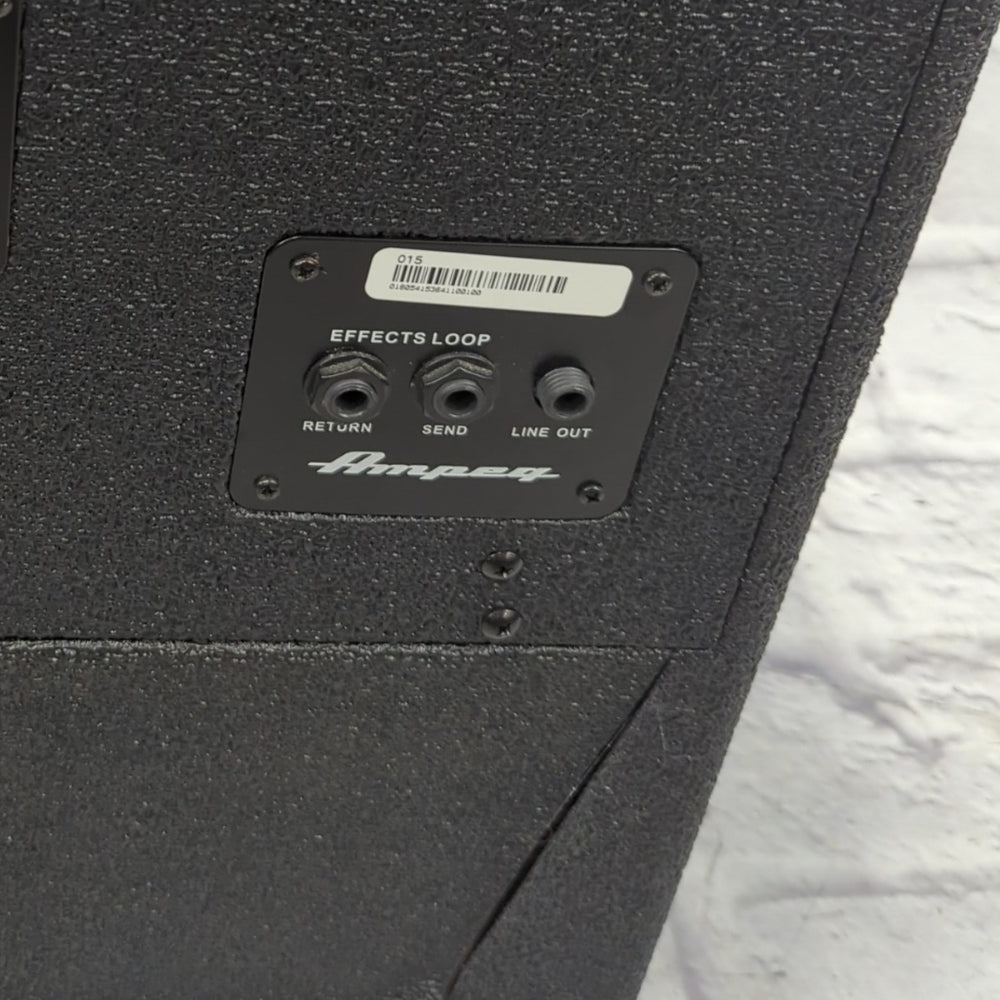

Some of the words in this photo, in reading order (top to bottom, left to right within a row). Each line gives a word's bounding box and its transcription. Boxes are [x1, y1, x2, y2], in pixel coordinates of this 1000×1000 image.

[330, 329, 425, 345] EFFECTS
[432, 331, 490, 346] LOOP
[302, 420, 372, 433] RETURN
[422, 424, 468, 436] SEND
[511, 427, 549, 438] LINE
[557, 427, 591, 438] OUT
[308, 451, 560, 482] Ampeg
